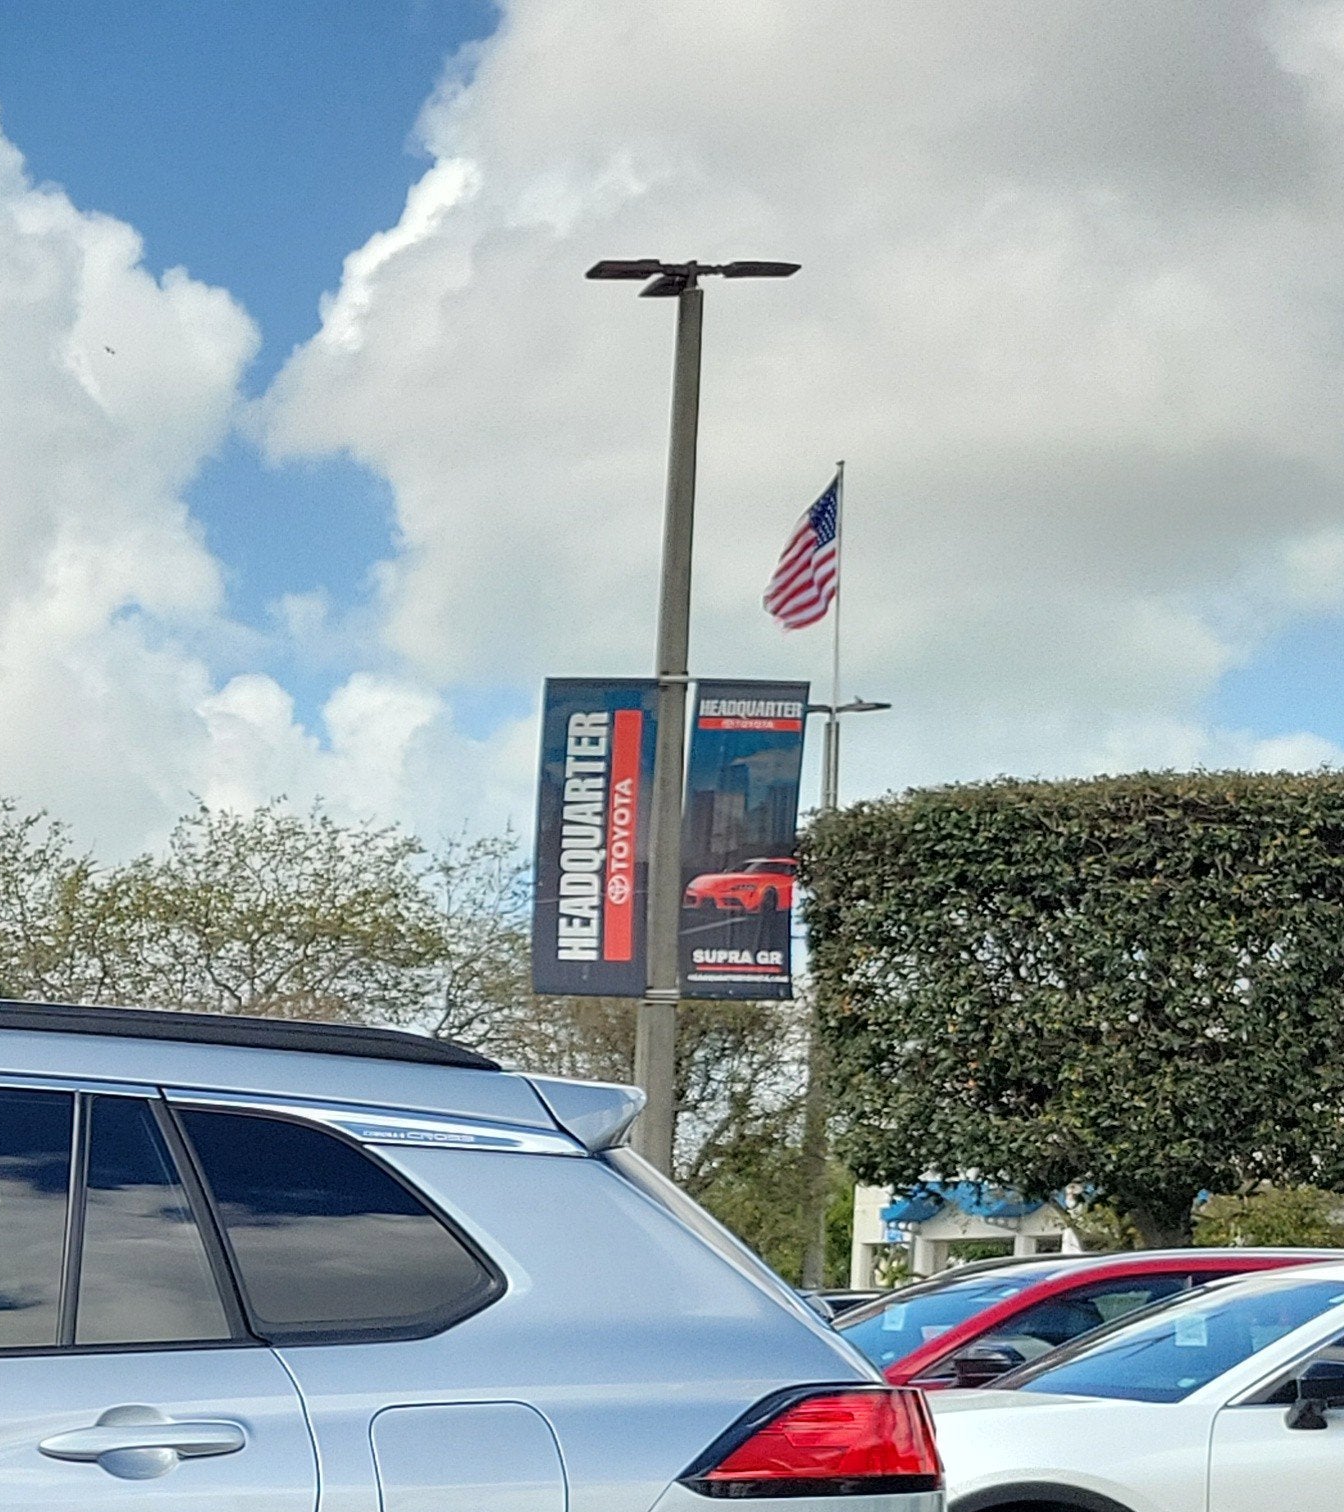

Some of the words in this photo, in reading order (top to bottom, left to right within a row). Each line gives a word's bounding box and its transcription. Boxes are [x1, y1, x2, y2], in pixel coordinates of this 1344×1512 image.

[699, 699, 803, 719] HEADQUARTER
[557, 711, 610, 961] HEADQUARTER
[610, 778, 633, 871] TOYOTA
[692, 949, 753, 964] SUPRA
[755, 950, 783, 965] GR
